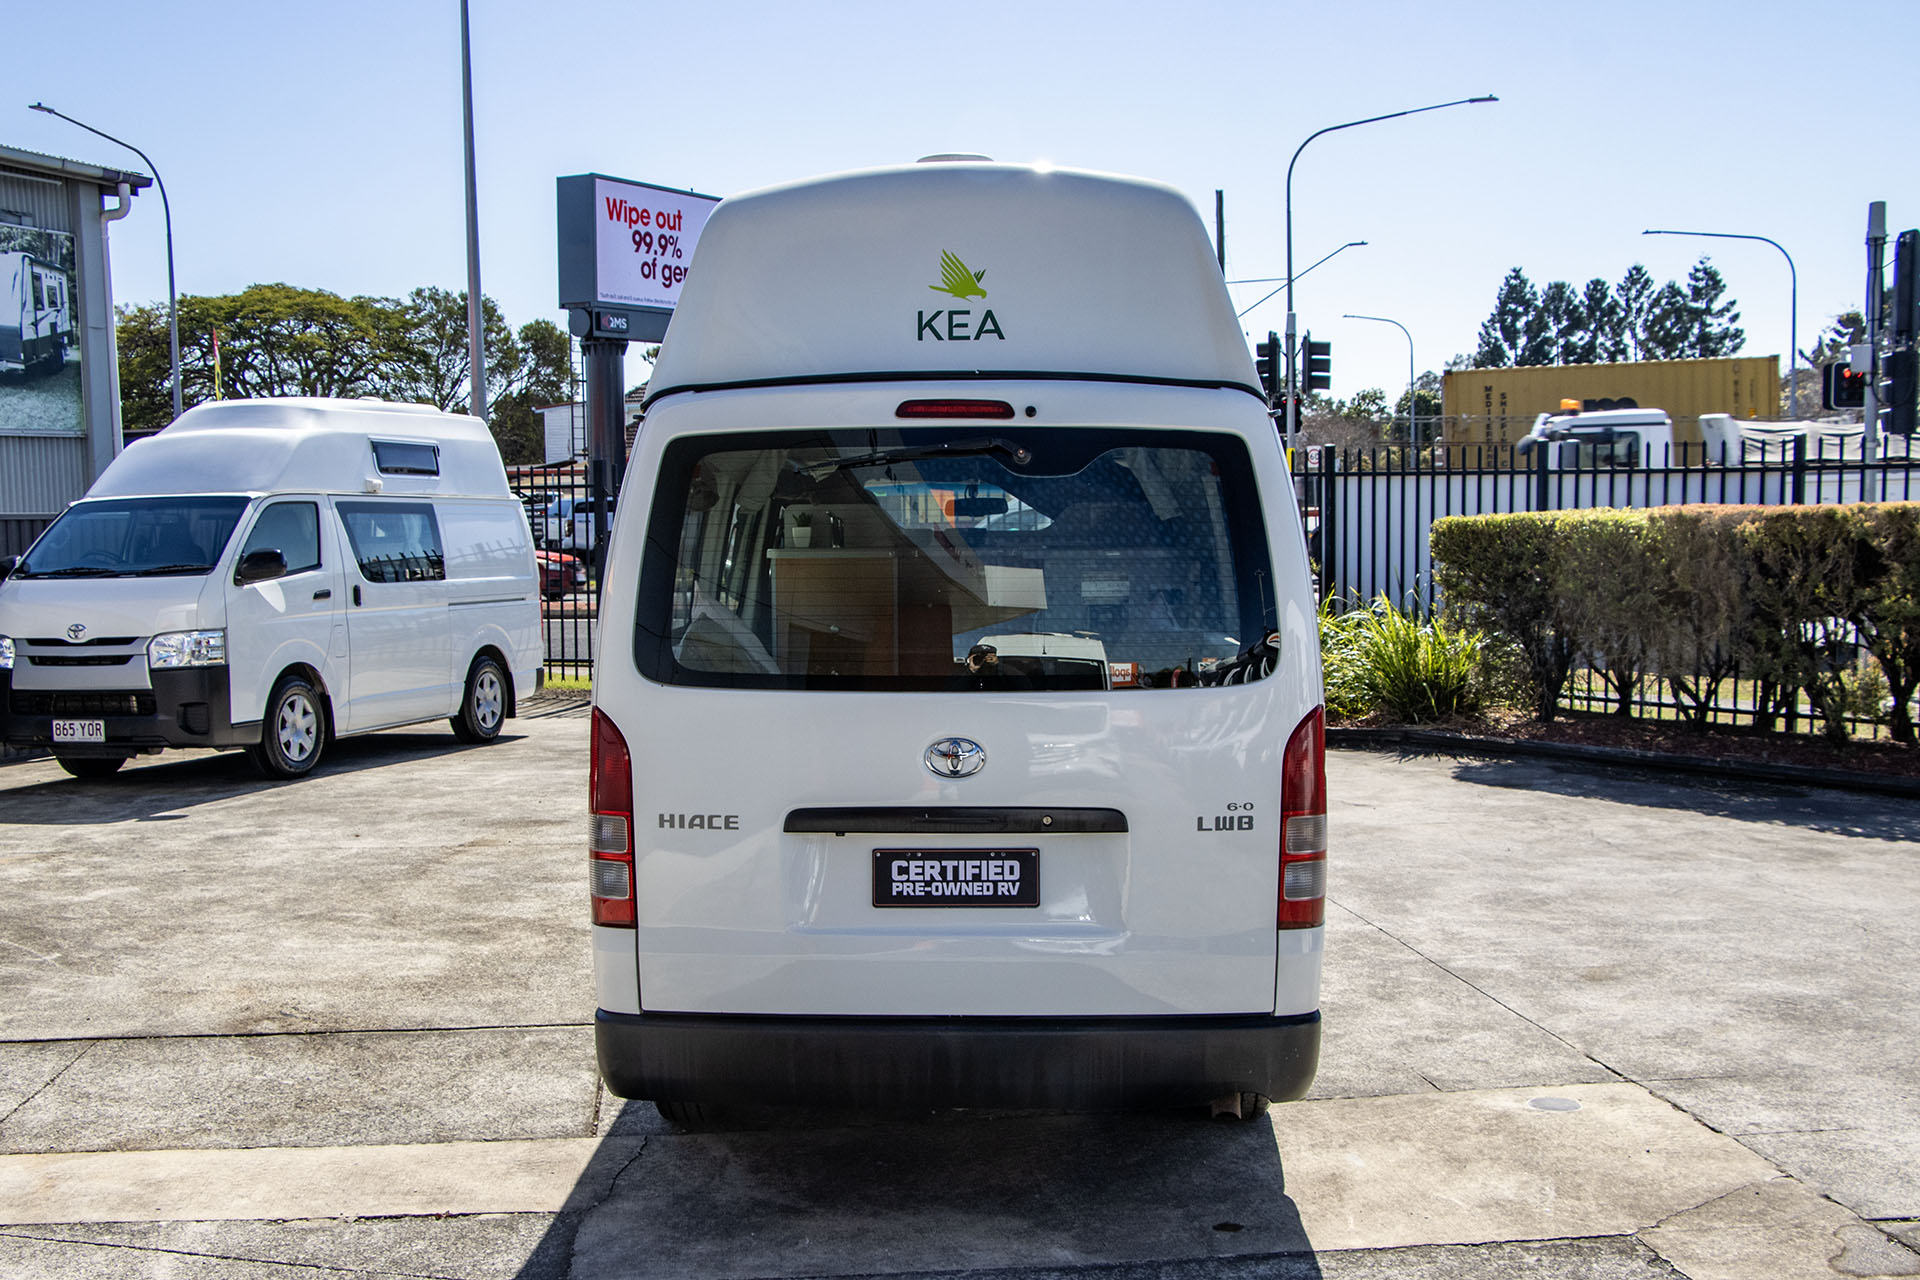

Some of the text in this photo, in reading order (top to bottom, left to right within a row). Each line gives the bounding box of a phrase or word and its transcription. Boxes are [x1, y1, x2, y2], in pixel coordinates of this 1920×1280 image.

[605, 197, 683, 232] Wipe out
[632, 230, 683, 259] 99.9%
[641, 257, 657, 280] of
[917, 309, 1006, 341] KEA
[659, 813, 739, 830] HIACE
[1197, 815, 1254, 831] LWB
[891, 860, 1021, 881] CERTIFIED
[891, 881, 1020, 897] PRE-OWNED RV
